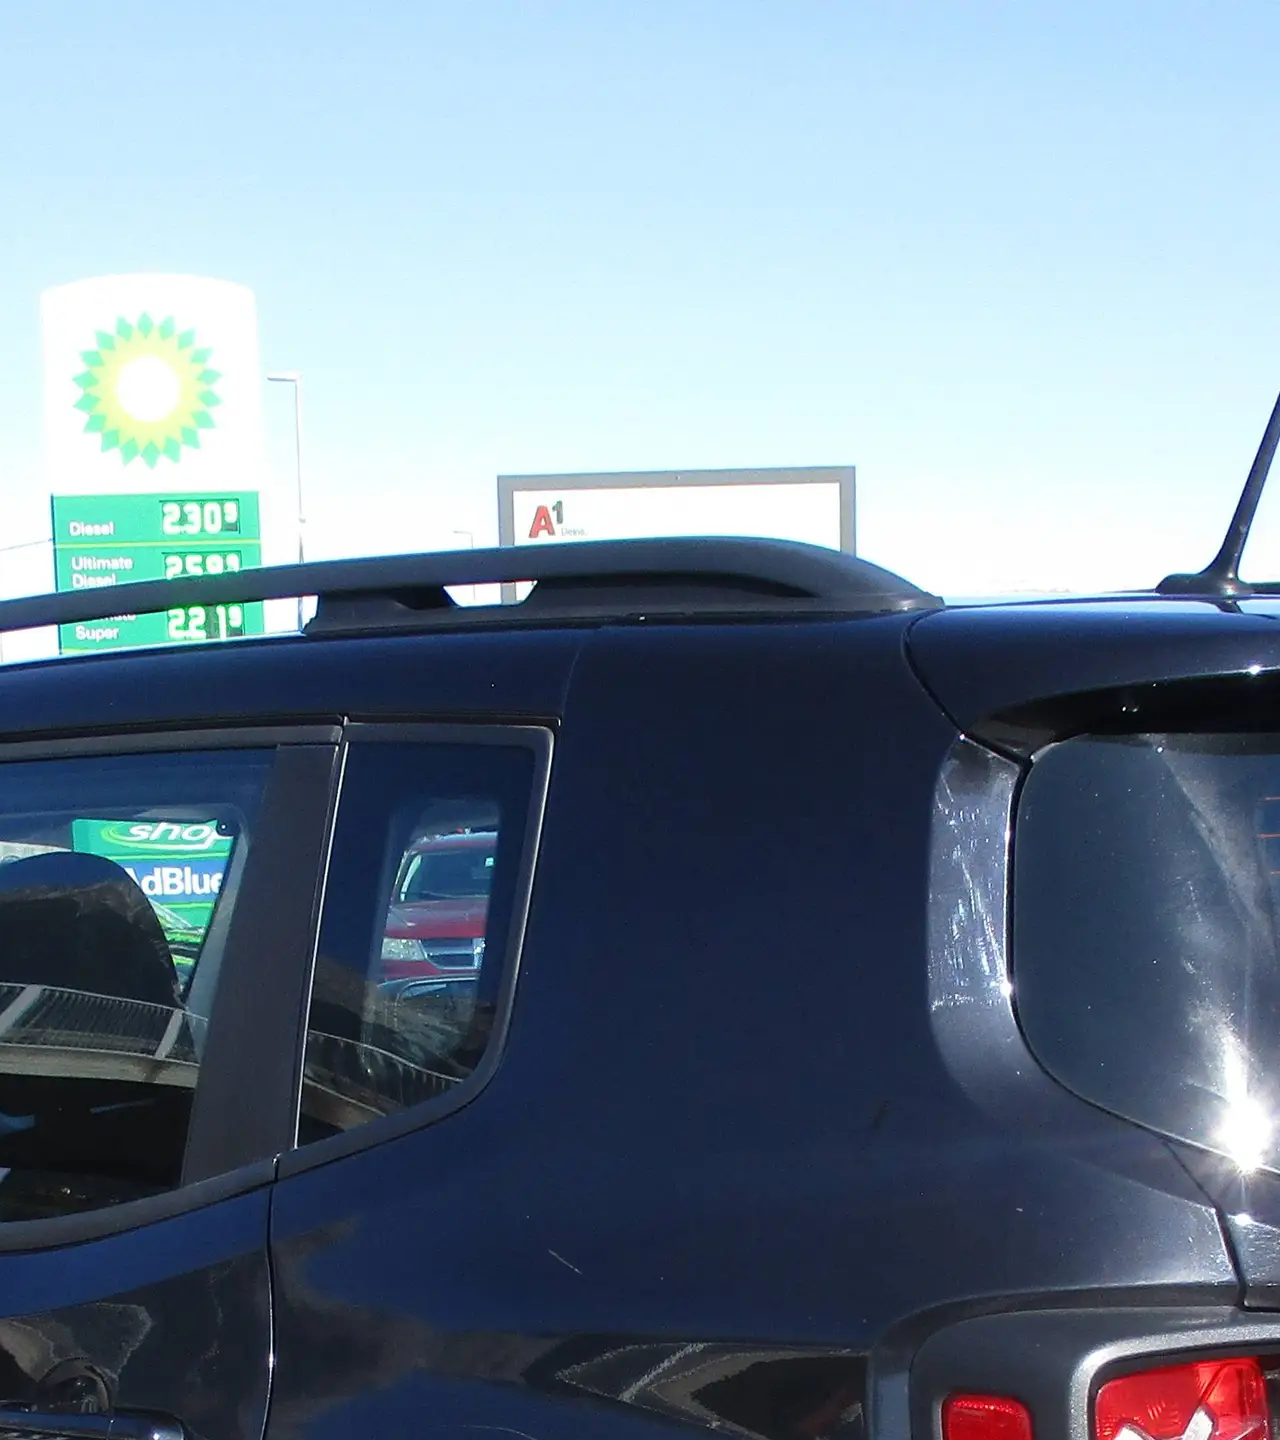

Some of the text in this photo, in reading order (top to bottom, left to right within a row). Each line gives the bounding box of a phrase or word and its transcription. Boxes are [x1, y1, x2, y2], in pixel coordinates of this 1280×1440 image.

[528, 500, 563, 538] A1
[69, 521, 115, 537] Diesel
[71, 556, 133, 571] Ultimate
[71, 573, 117, 588] Diesel
[75, 625, 120, 643] Super
